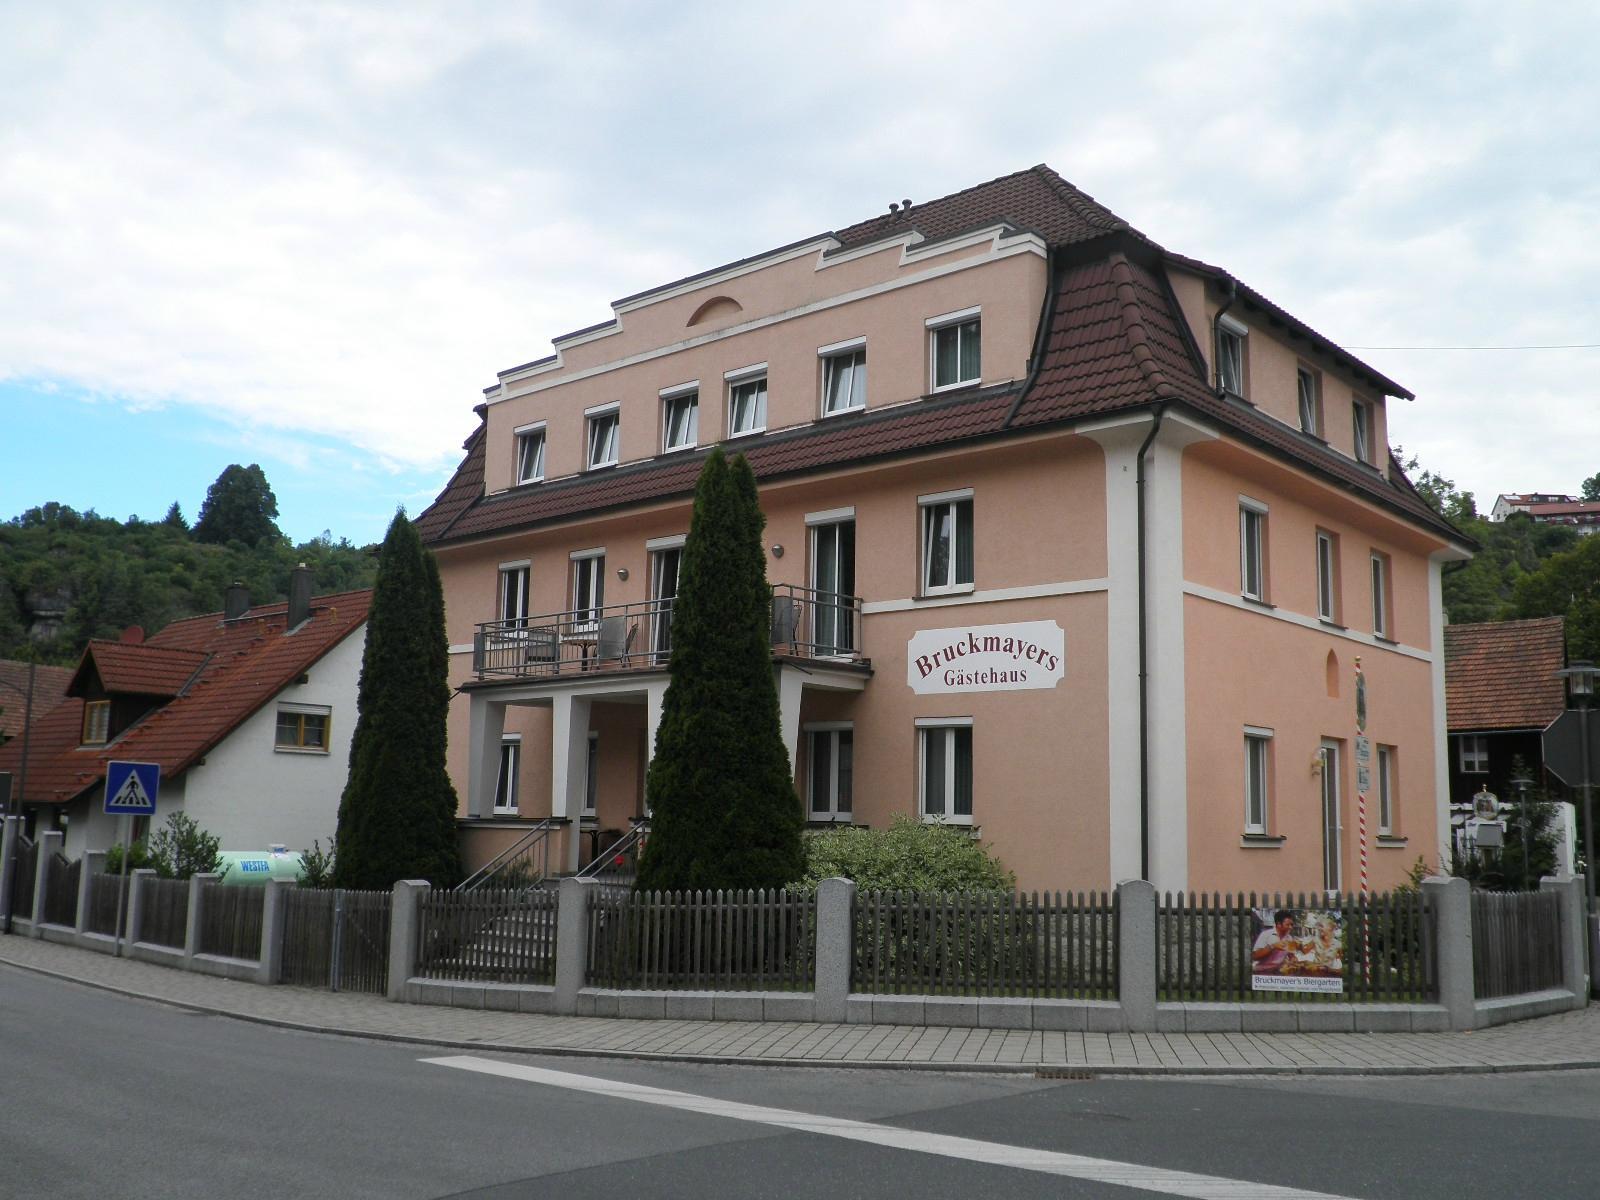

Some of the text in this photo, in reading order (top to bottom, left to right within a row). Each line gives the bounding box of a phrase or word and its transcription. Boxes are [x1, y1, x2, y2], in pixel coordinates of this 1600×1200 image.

[914, 632, 1060, 679] Bruckmayers
[943, 667, 1028, 687] Gästehaus
[240, 860, 271, 873] WESTFA
[1303, 977, 1341, 987] Biergarten
